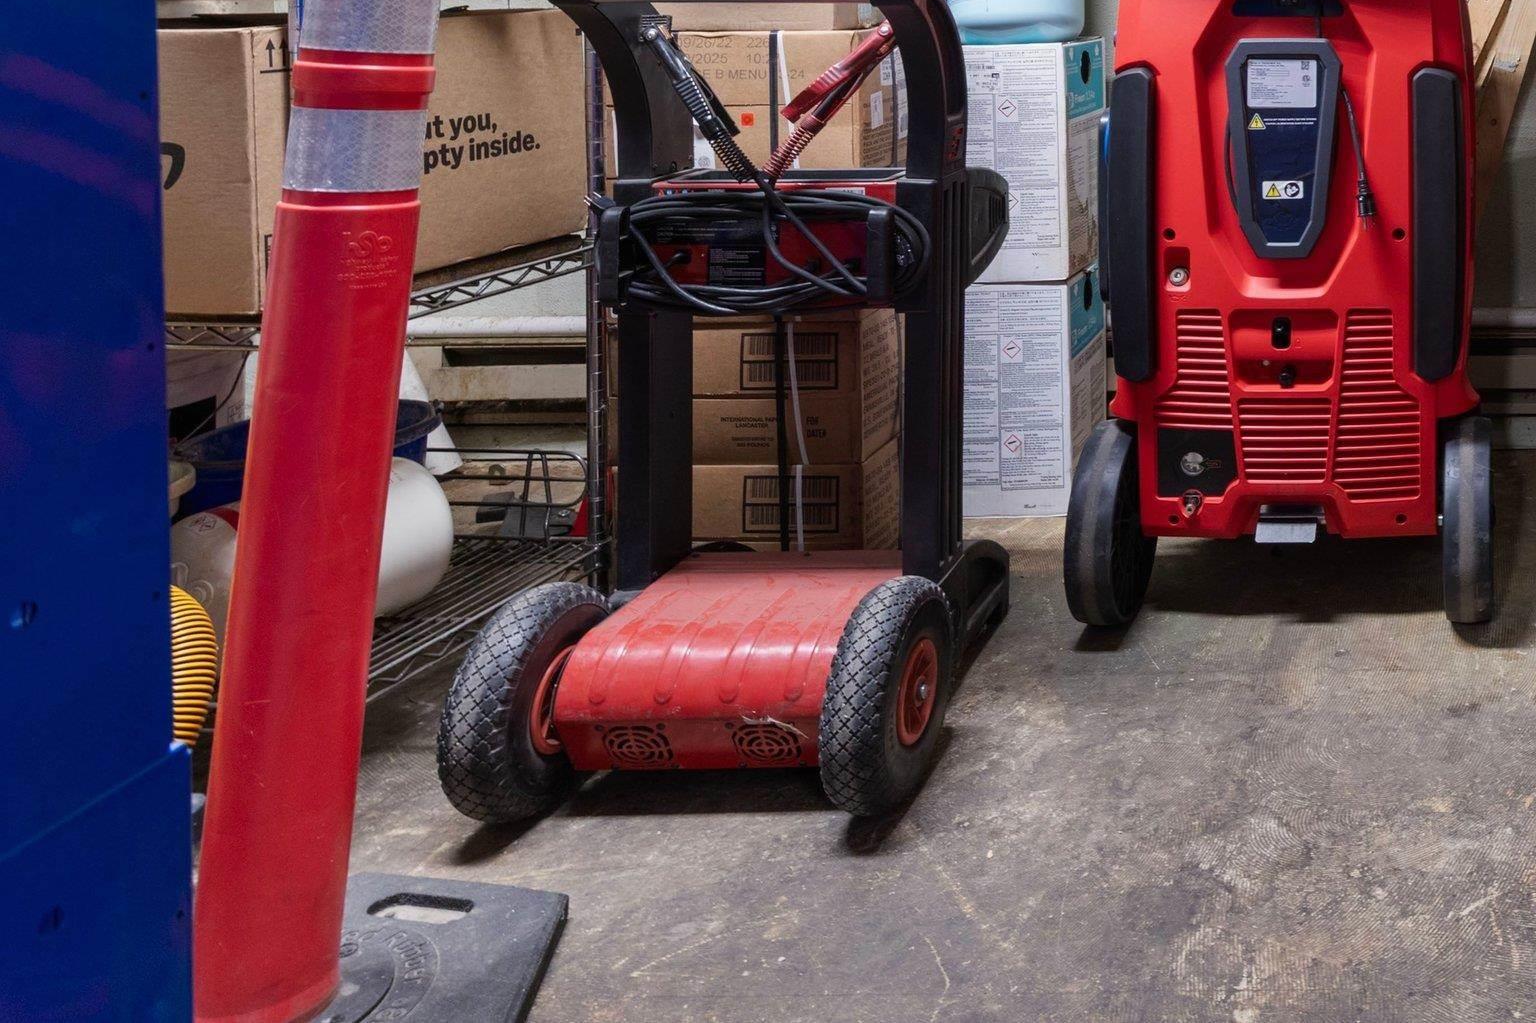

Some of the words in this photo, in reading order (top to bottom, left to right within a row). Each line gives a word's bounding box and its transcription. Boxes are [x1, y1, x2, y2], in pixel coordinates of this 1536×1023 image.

[746, 53, 769, 64] 10:
[716, 70, 725, 79] B
[728, 70, 767, 80] MENU
[449, 113, 497, 141] you,
[469, 130, 541, 162] inside.
